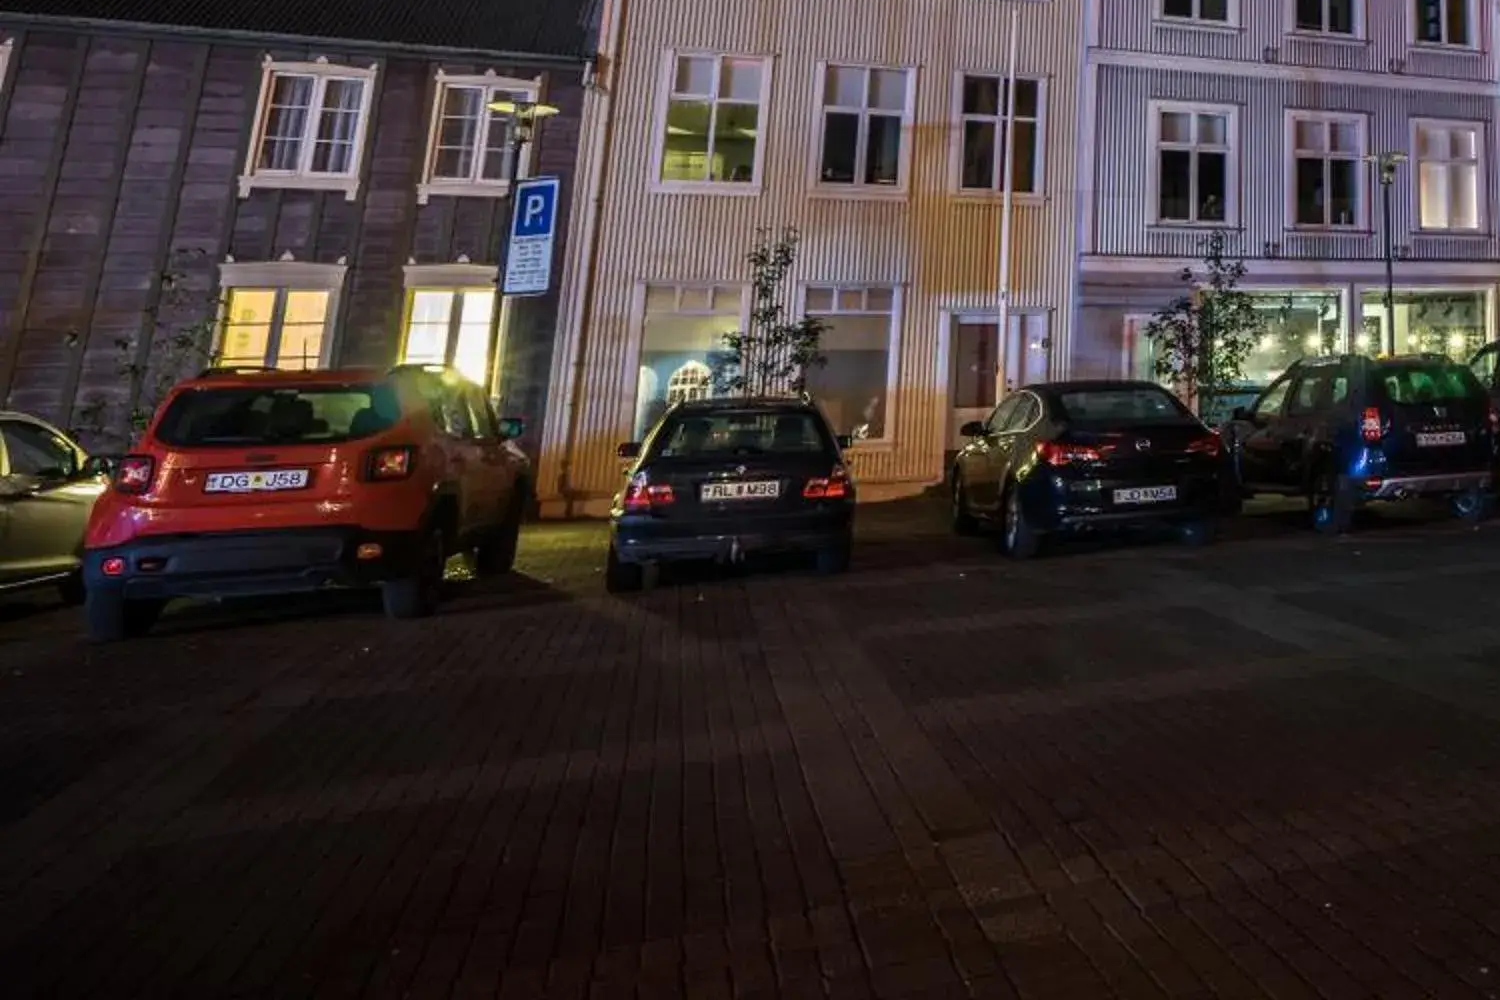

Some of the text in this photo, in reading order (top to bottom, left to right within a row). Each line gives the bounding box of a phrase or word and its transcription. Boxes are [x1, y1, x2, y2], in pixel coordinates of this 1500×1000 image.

[524, 194, 545, 228] P
[220, 472, 301, 489] DG J58
